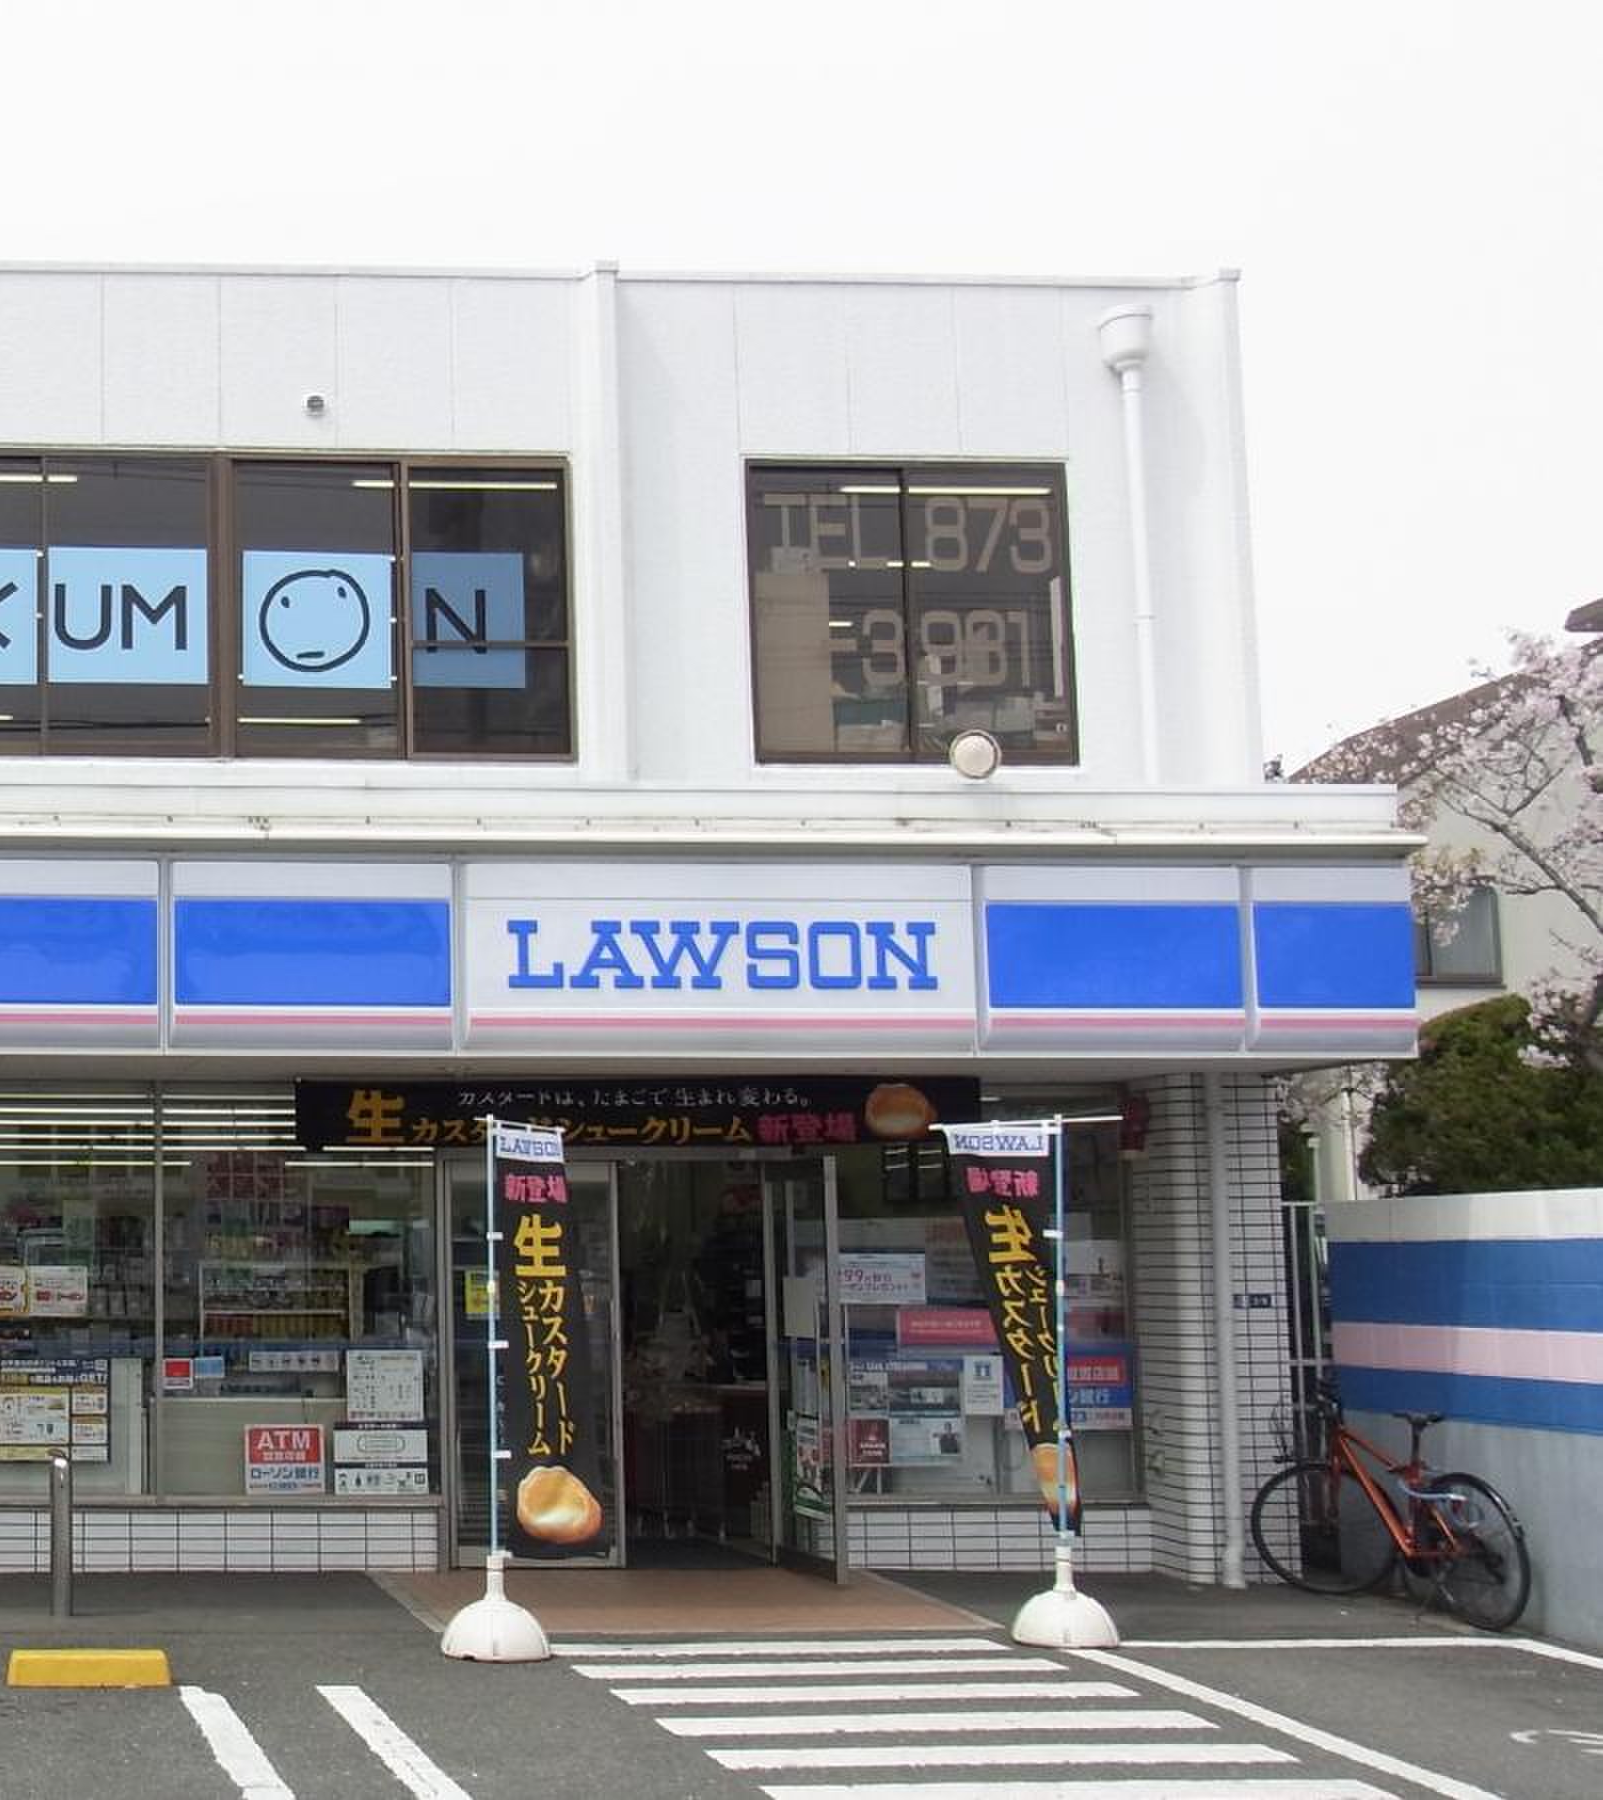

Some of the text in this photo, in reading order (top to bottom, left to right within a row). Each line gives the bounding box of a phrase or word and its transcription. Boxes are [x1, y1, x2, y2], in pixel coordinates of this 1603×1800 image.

[763, 494, 1052, 573] TEL 873
[506, 919, 940, 991] LAWSON
[345, 1089, 406, 1144] 生
[757, 1112, 856, 1143] 新登場
[504, 1172, 568, 1205] 新登場
[513, 1213, 567, 1278] 生
[516, 1280, 552, 1456] シュークリーム
[539, 1279, 575, 1456] カスタード
[257, 1431, 310, 1450] ATM
